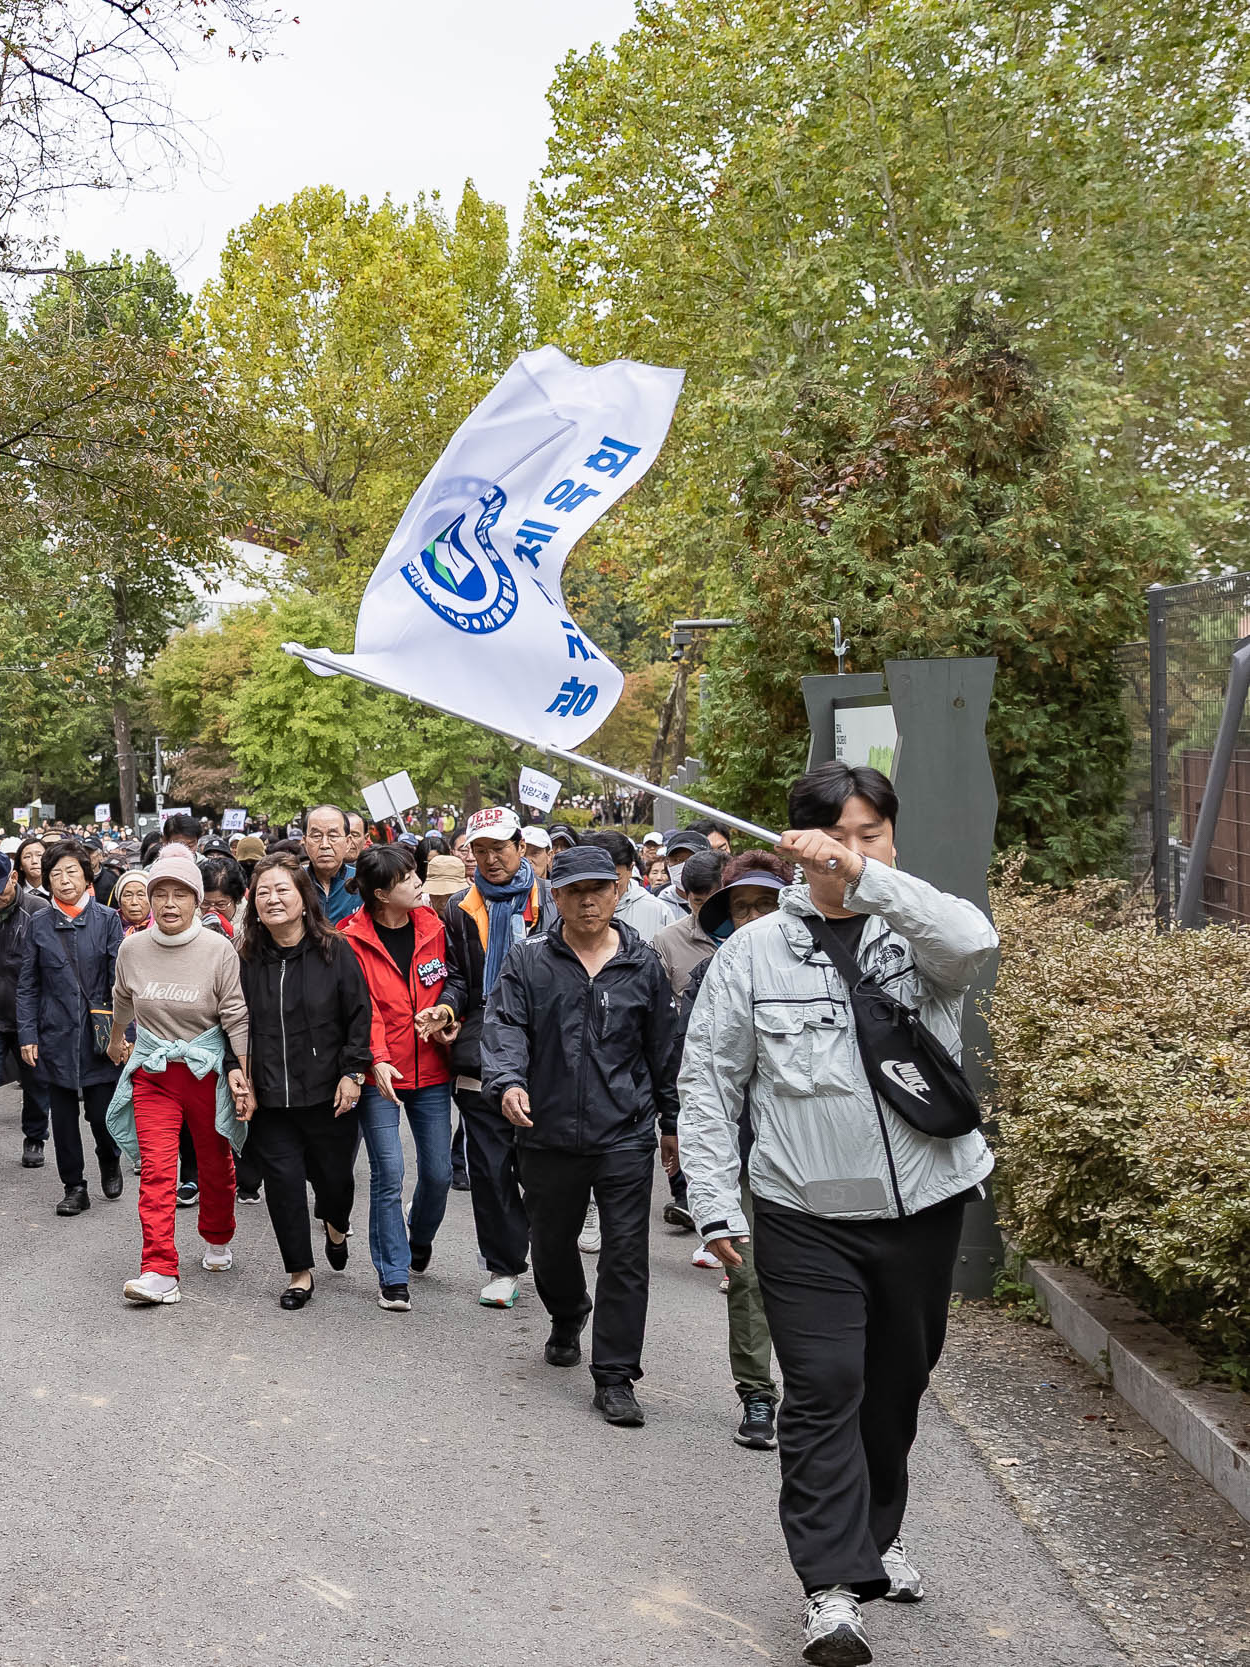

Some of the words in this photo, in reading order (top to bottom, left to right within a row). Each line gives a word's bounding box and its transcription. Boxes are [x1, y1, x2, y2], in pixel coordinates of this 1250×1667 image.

[470, 809, 503, 828] JEEP
[138, 981, 200, 1002] Mellow
[895, 1062, 931, 1096] NIKE
